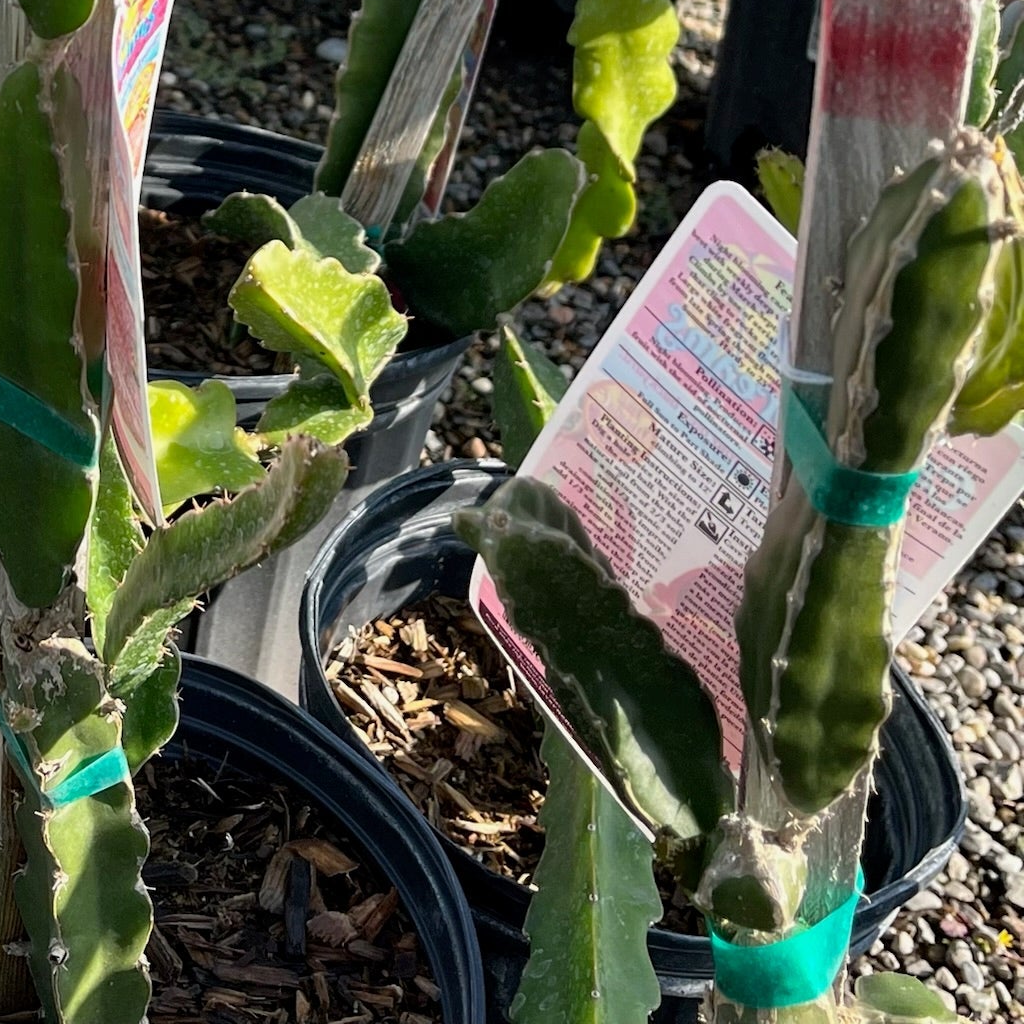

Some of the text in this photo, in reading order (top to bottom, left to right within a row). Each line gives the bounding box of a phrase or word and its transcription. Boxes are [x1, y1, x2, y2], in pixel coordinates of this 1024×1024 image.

[687, 254, 742, 311] Climbs use
[690, 228, 776, 316] best with weekly deep
[701, 255, 731, 287] during
[708, 233, 734, 261] Night
[731, 256, 771, 298] blooming
[667, 277, 689, 299] from
[688, 296, 705, 314] late
[703, 312, 733, 342] Spring
[731, 338, 766, 374] through
[675, 271, 759, 353] Large white fragrant
[688, 269, 760, 341] that cling rocks
[717, 338, 746, 368] Hardy
[745, 364, 757, 377] to
[630, 331, 748, 443] fruit with the aid of nocturnal
[647, 336, 753, 436] Night blooming. Produces
[694, 365, 760, 428] Pollination:
[636, 390, 726, 474] Full Sun to Part Shade
[675, 411, 734, 467] Exposure:
[692, 403, 743, 450] pollinators.
[590, 418, 697, 517] Dig a hole twice the size of
[598, 413, 703, 509] Planting Instructions:
[647, 421, 718, 488] Mature Size:
[648, 438, 699, 484] climbing to
[936, 449, 986, 485] con riego
[575, 440, 600, 463] make
[605, 466, 639, 499] mixture
[638, 496, 649, 508] of
[649, 506, 666, 523] 2/3
[665, 521, 683, 538] soil
[577, 465, 673, 553] conditioner. improve
[583, 435, 688, 532] natural soil from the hole,
[596, 471, 678, 545] and 1/3 organic soil
[604, 442, 692, 523] the root ball. With the
[922, 462, 976, 503] Trepa por
[930, 492, 947, 506] los
[933, 483, 954, 500] que
[551, 463, 663, 565] add 1/3 sand to the mixture.
[557, 459, 669, 560] drainage with heavier soils,
[912, 502, 964, 540] final de la
[913, 514, 956, 546] Verano.
[922, 498, 968, 532] blancas,
[582, 501, 659, 572] Remove plant from
[587, 517, 654, 578] and place hole
[592, 532, 649, 585] that the top of
[722, 538, 743, 557] Cave
[612, 560, 646, 592] with the
[621, 579, 641, 598] with
[693, 580, 711, 597] más
[698, 573, 718, 591] Para
[707, 559, 737, 585] mezcla
[712, 552, 743, 579] natural
[678, 601, 727, 644] agujero (con
[684, 593, 728, 633] contenedor
[695, 592, 704, 601] la
[661, 627, 688, 652] mezcla
[687, 650, 699, 661] de
[665, 620, 703, 654] alrededor
[702, 653, 713, 664] de
[713, 662, 722, 671] la
[670, 613, 686, 629] esté
[692, 634, 705, 647] ras
[706, 646, 720, 660] con
[720, 658, 729, 668] la
[673, 608, 720, 649] que la parte
